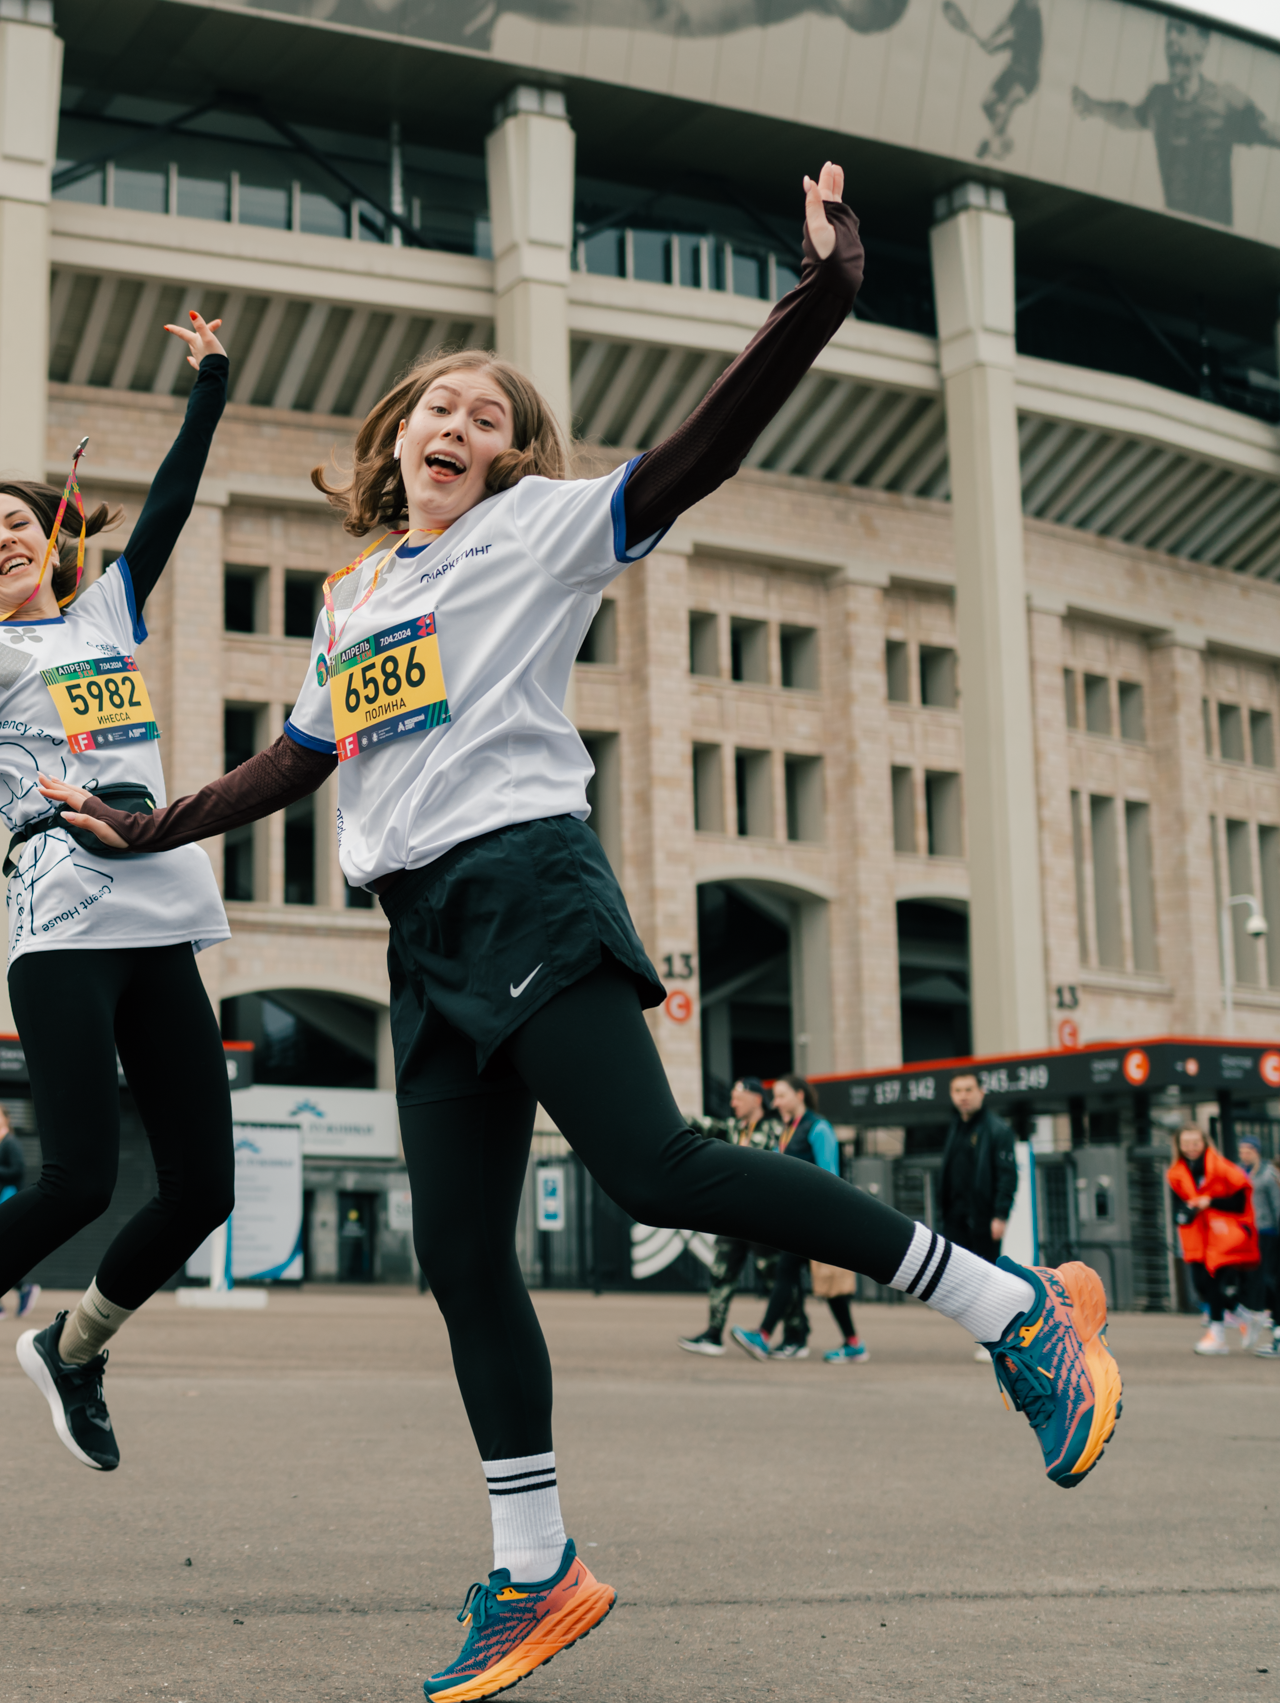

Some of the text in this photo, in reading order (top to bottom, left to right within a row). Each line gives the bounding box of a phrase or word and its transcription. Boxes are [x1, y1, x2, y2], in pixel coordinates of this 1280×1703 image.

[379, 628, 411, 646] 7.04.2024
[341, 640, 370, 663] АПРЕЛЬ
[58, 661, 91, 676] АПРЕЛЬ
[345, 645, 426, 713] 6586
[65, 676, 142, 716] 5982
[97, 712, 131, 725] ИНЕССА
[365, 698, 407, 722] ПОЛИНА
[77, 733, 88, 750] F
[345, 736, 354, 757] F
[41, 906, 81, 932] House
[662, 952, 693, 979] 13
[1056, 985, 1079, 1009] 13
[1036, 1269, 1074, 1308] HOKA
